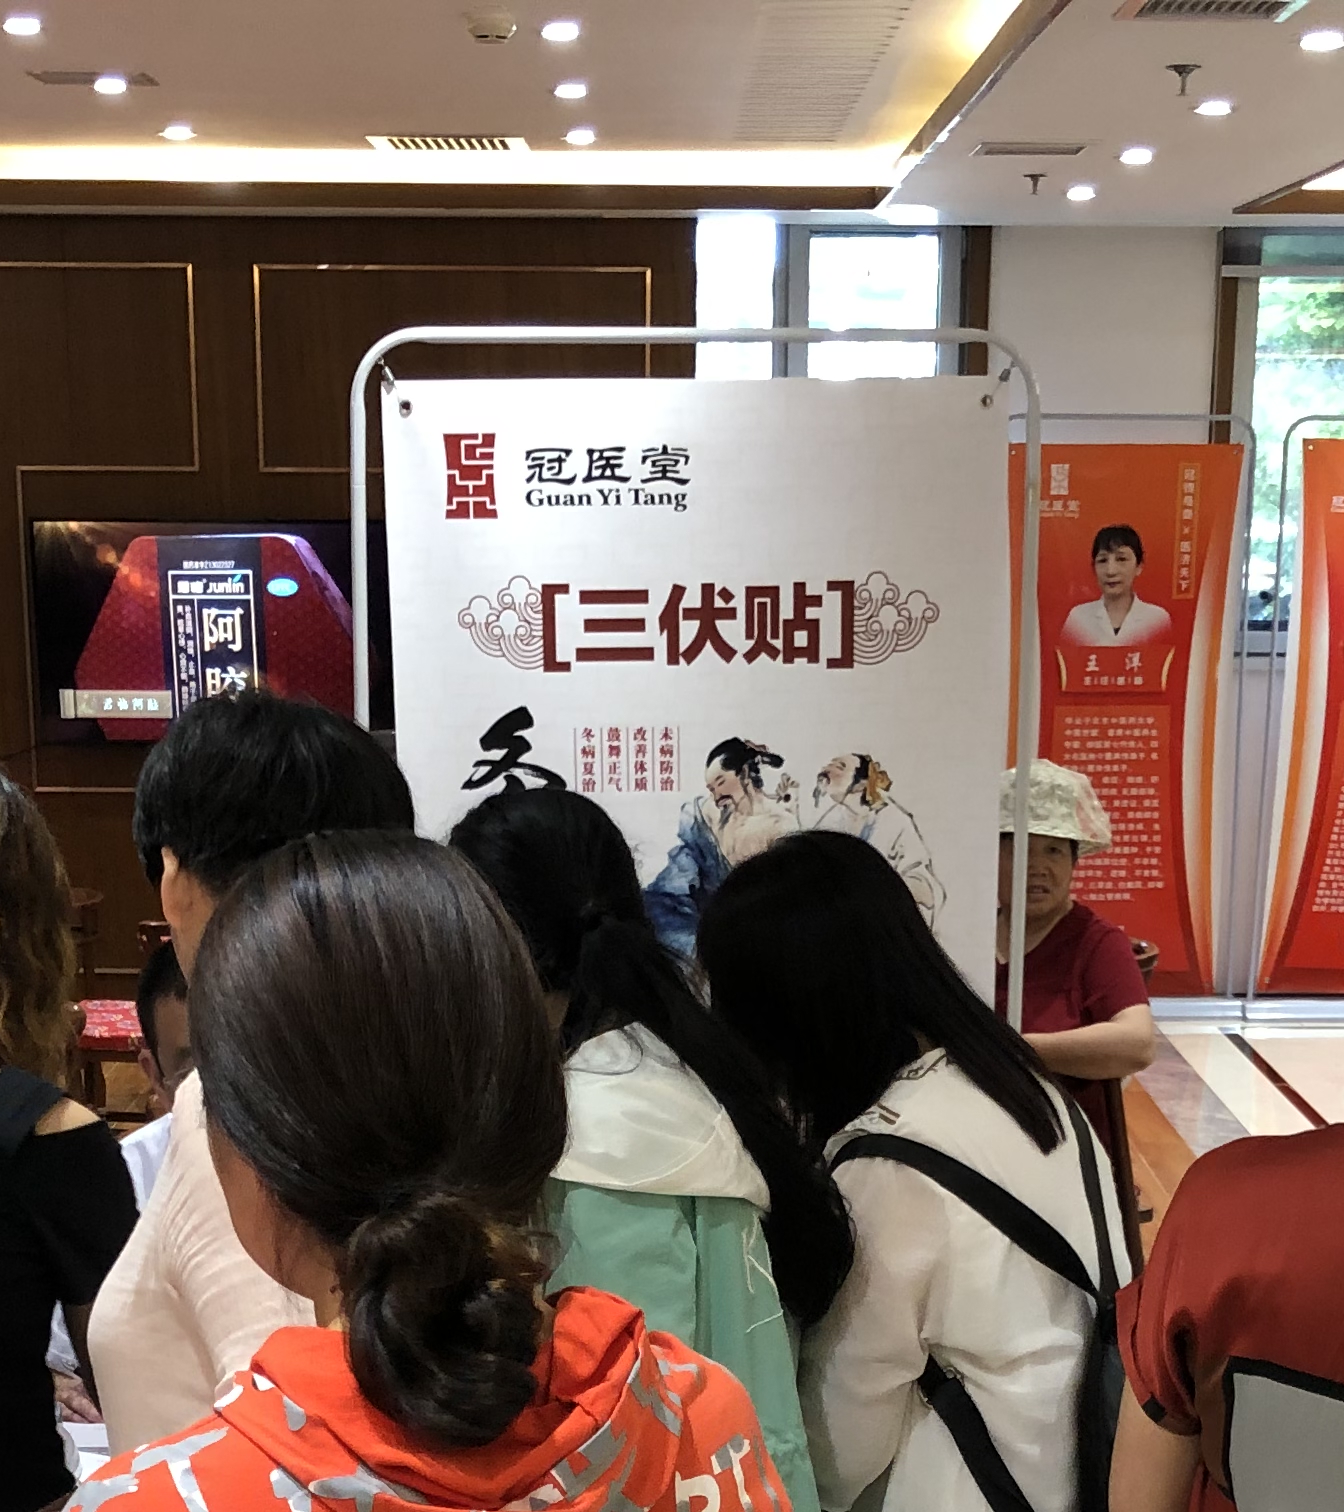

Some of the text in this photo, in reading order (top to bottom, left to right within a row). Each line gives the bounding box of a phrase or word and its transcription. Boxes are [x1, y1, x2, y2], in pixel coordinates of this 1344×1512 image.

[525, 444, 691, 486] 冠医堂
[525, 488, 688, 512] Guan Yi Tang
[580, 726, 597, 793] 冬病夏治
[606, 726, 622, 793] 鼓舞正气
[633, 726, 648, 793] 改善体质
[659, 726, 675, 793] 未病防治
